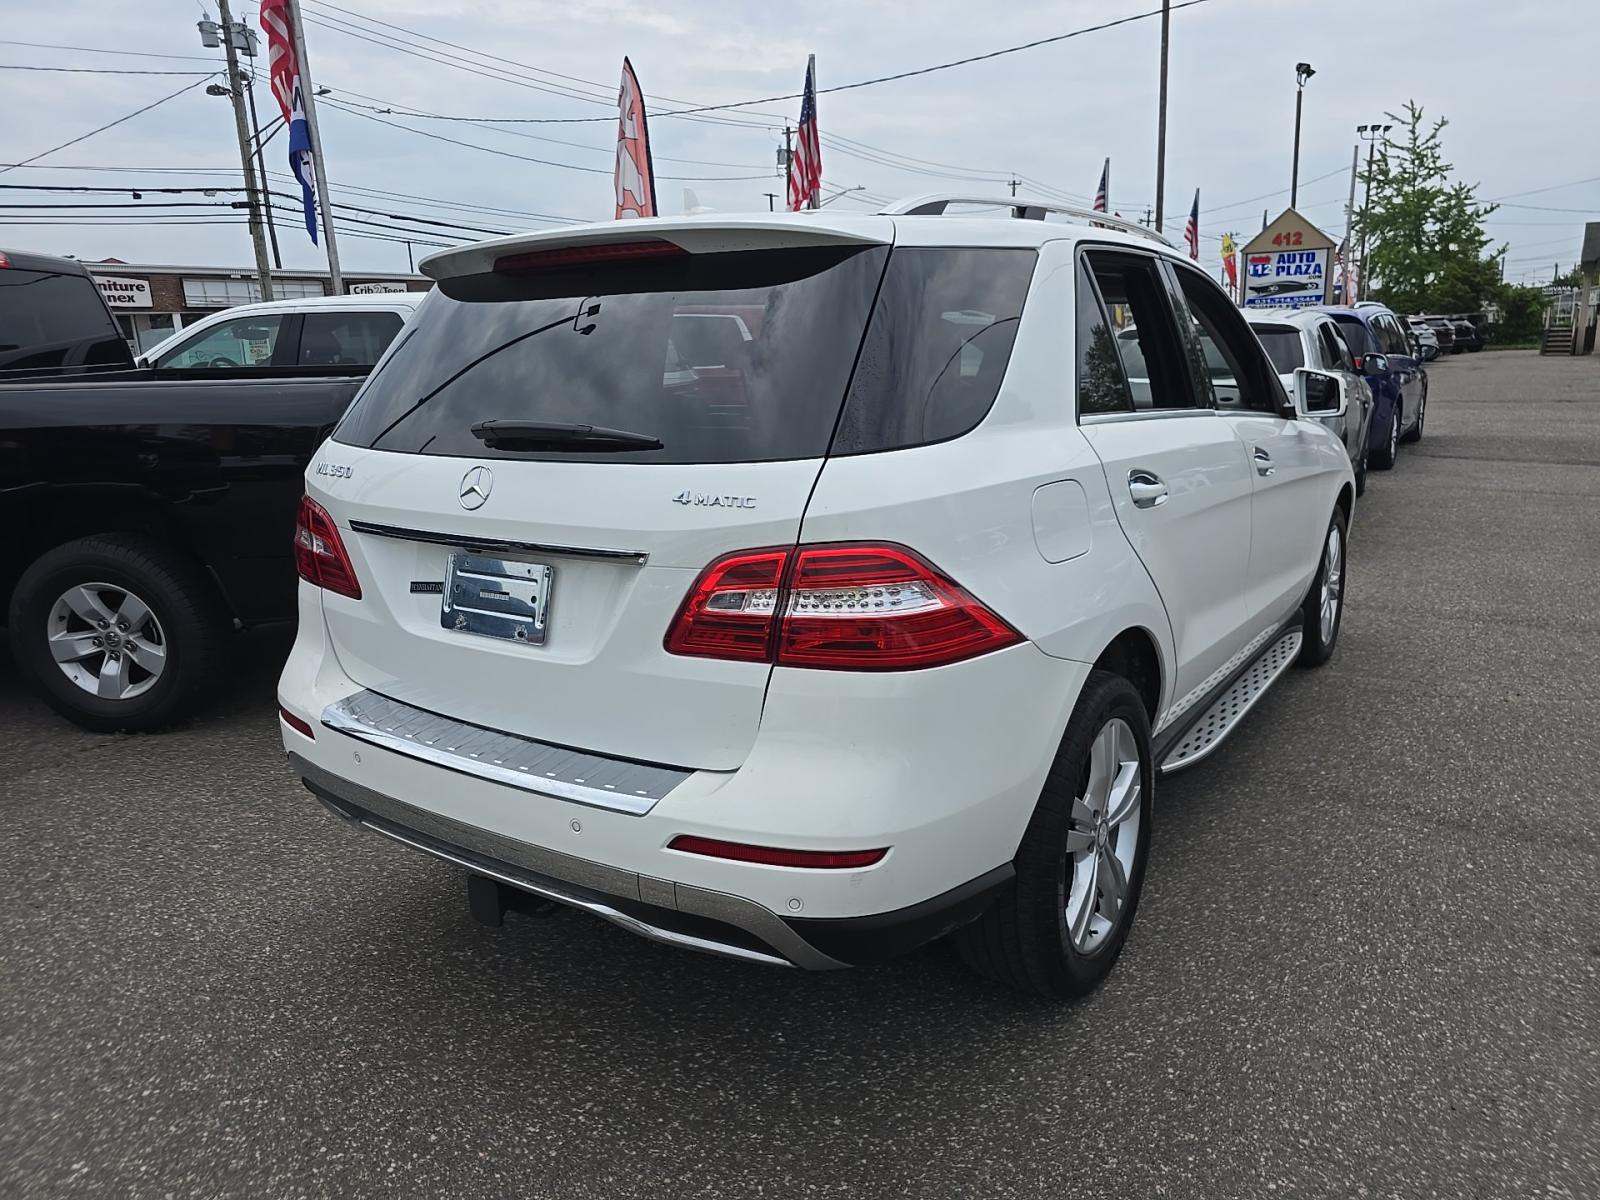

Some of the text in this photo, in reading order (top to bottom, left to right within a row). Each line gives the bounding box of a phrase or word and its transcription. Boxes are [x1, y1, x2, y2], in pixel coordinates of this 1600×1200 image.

[1272, 231, 1303, 247] 412
[1276, 252, 1316, 264] AUTO
[1275, 263, 1322, 276] PLAZA
